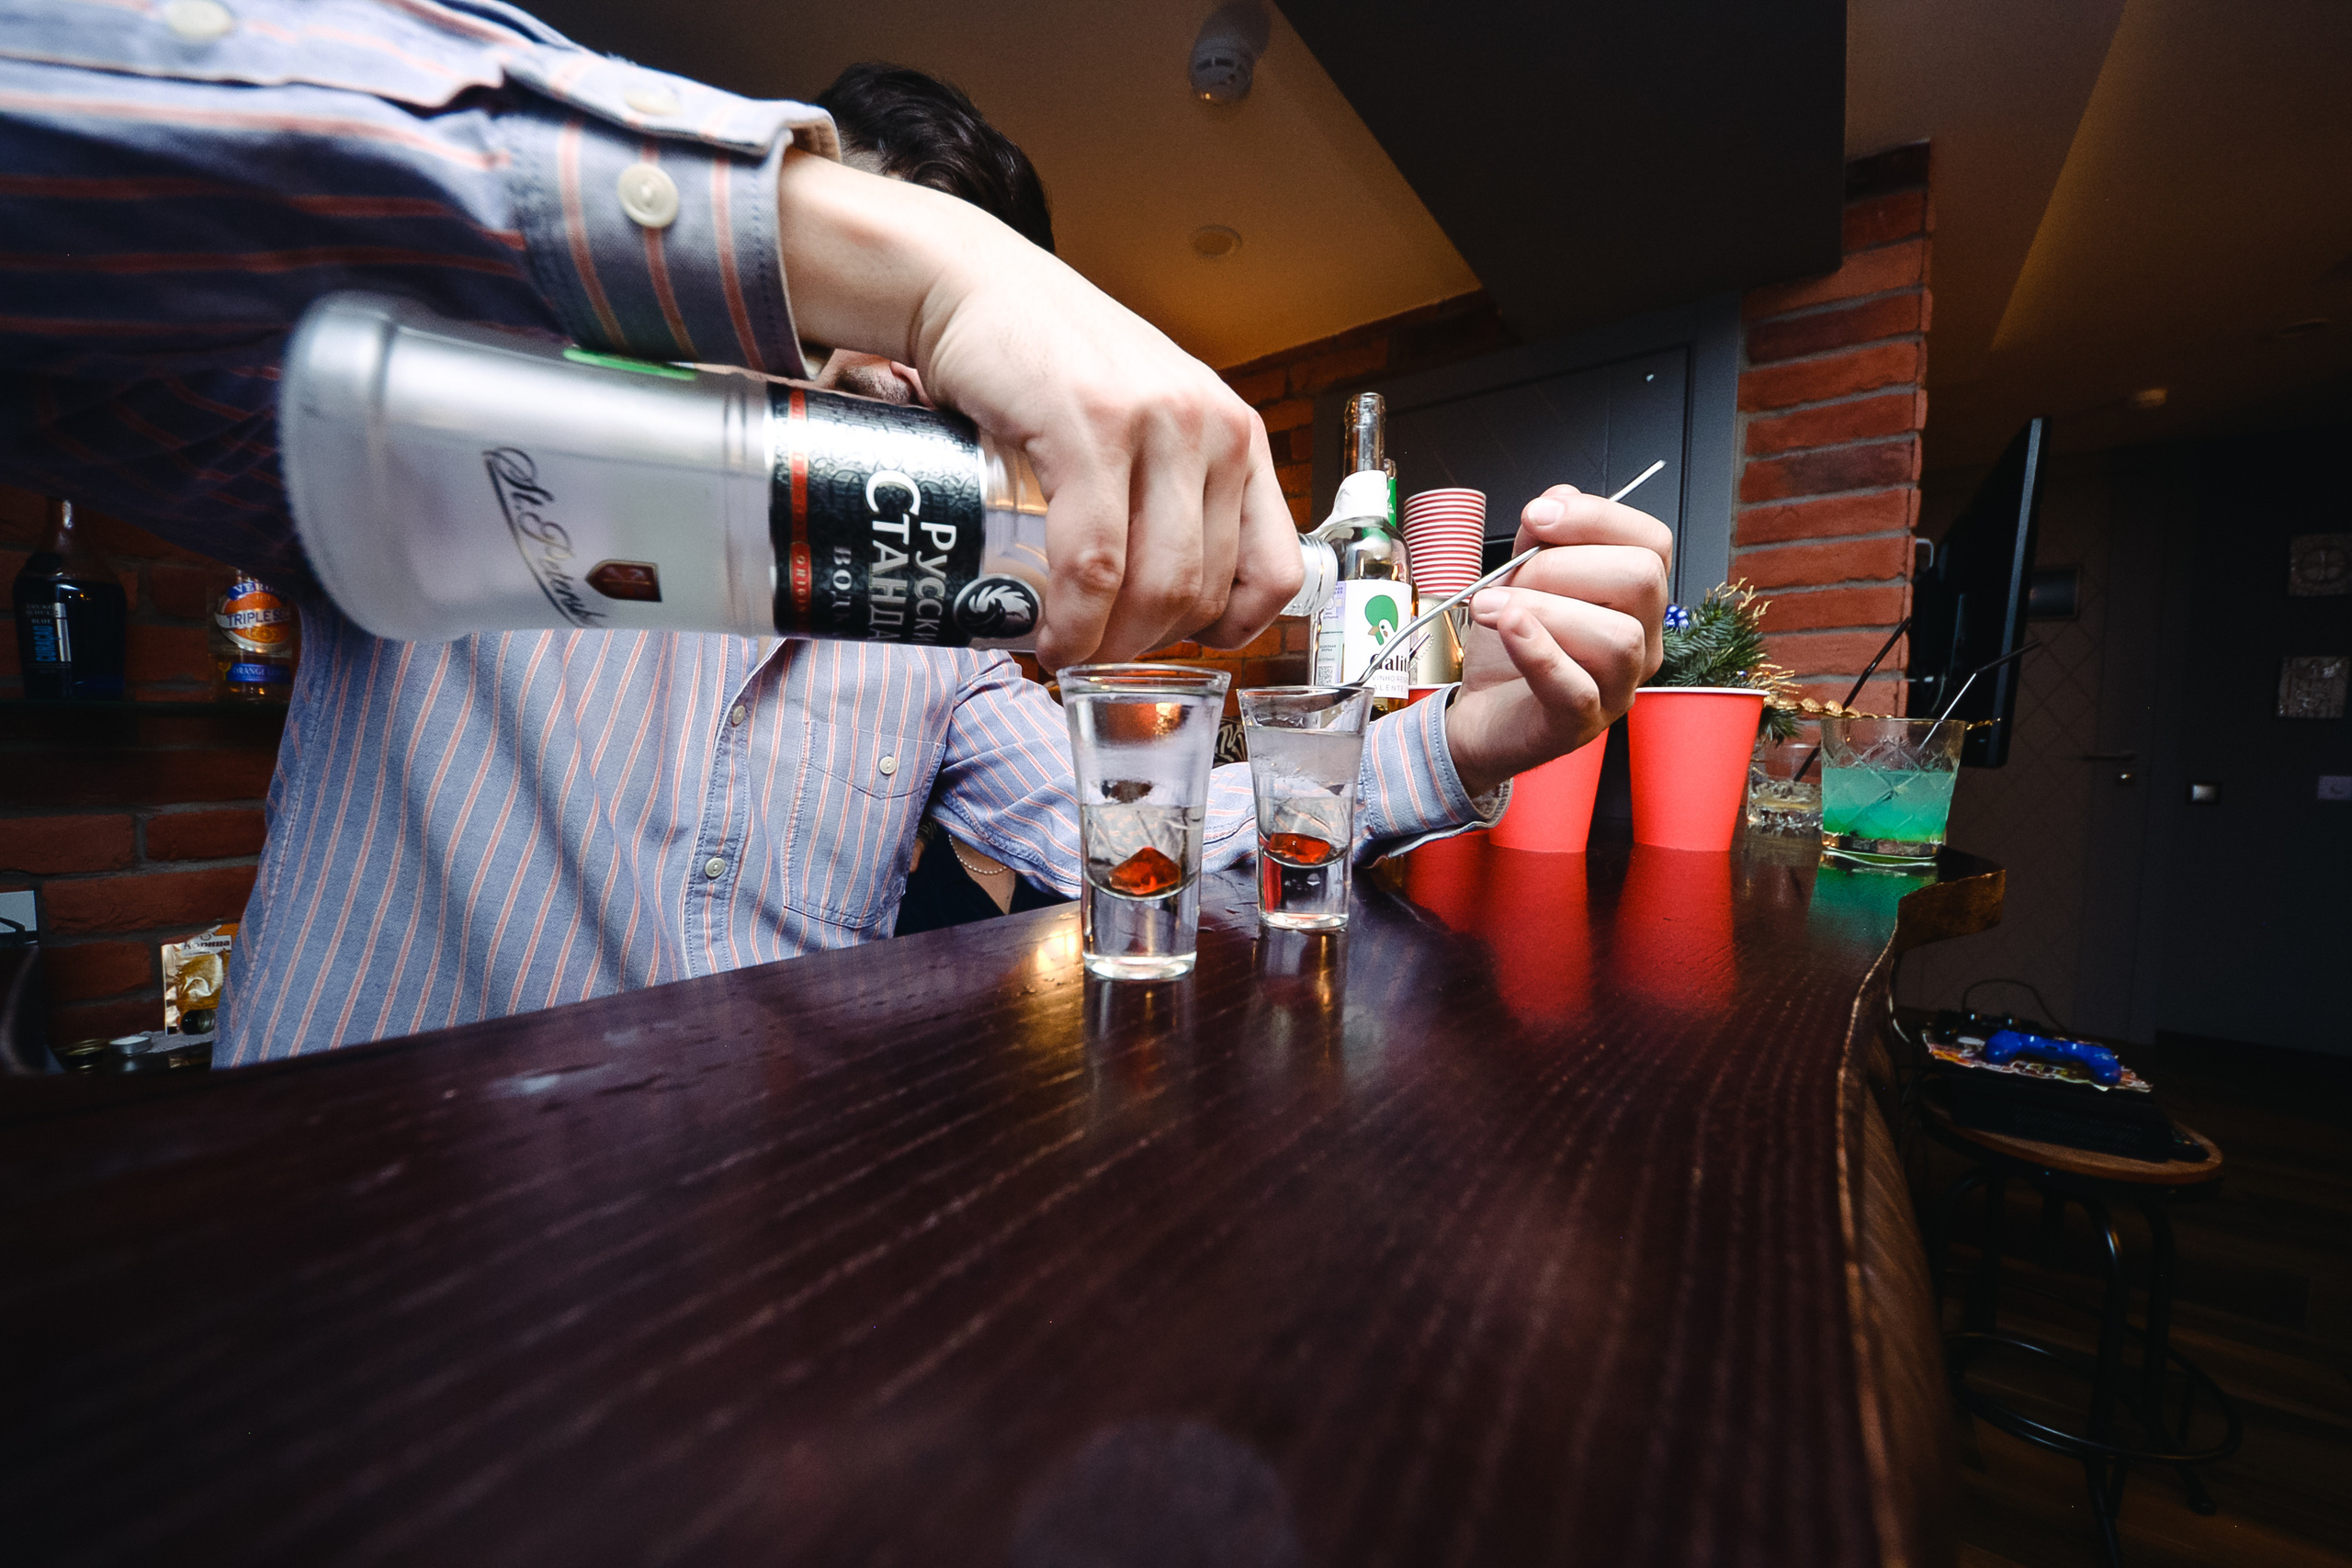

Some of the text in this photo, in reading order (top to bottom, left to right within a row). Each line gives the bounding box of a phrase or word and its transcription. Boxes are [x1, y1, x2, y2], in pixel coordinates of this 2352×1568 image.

[865, 469, 922, 641] СТАНДА
[914, 521, 956, 642] РУССКИ
[227, 609, 271, 626] TRIPLE
[1370, 653, 1408, 672] Galit
[1374, 684, 1407, 693] ALENTE
